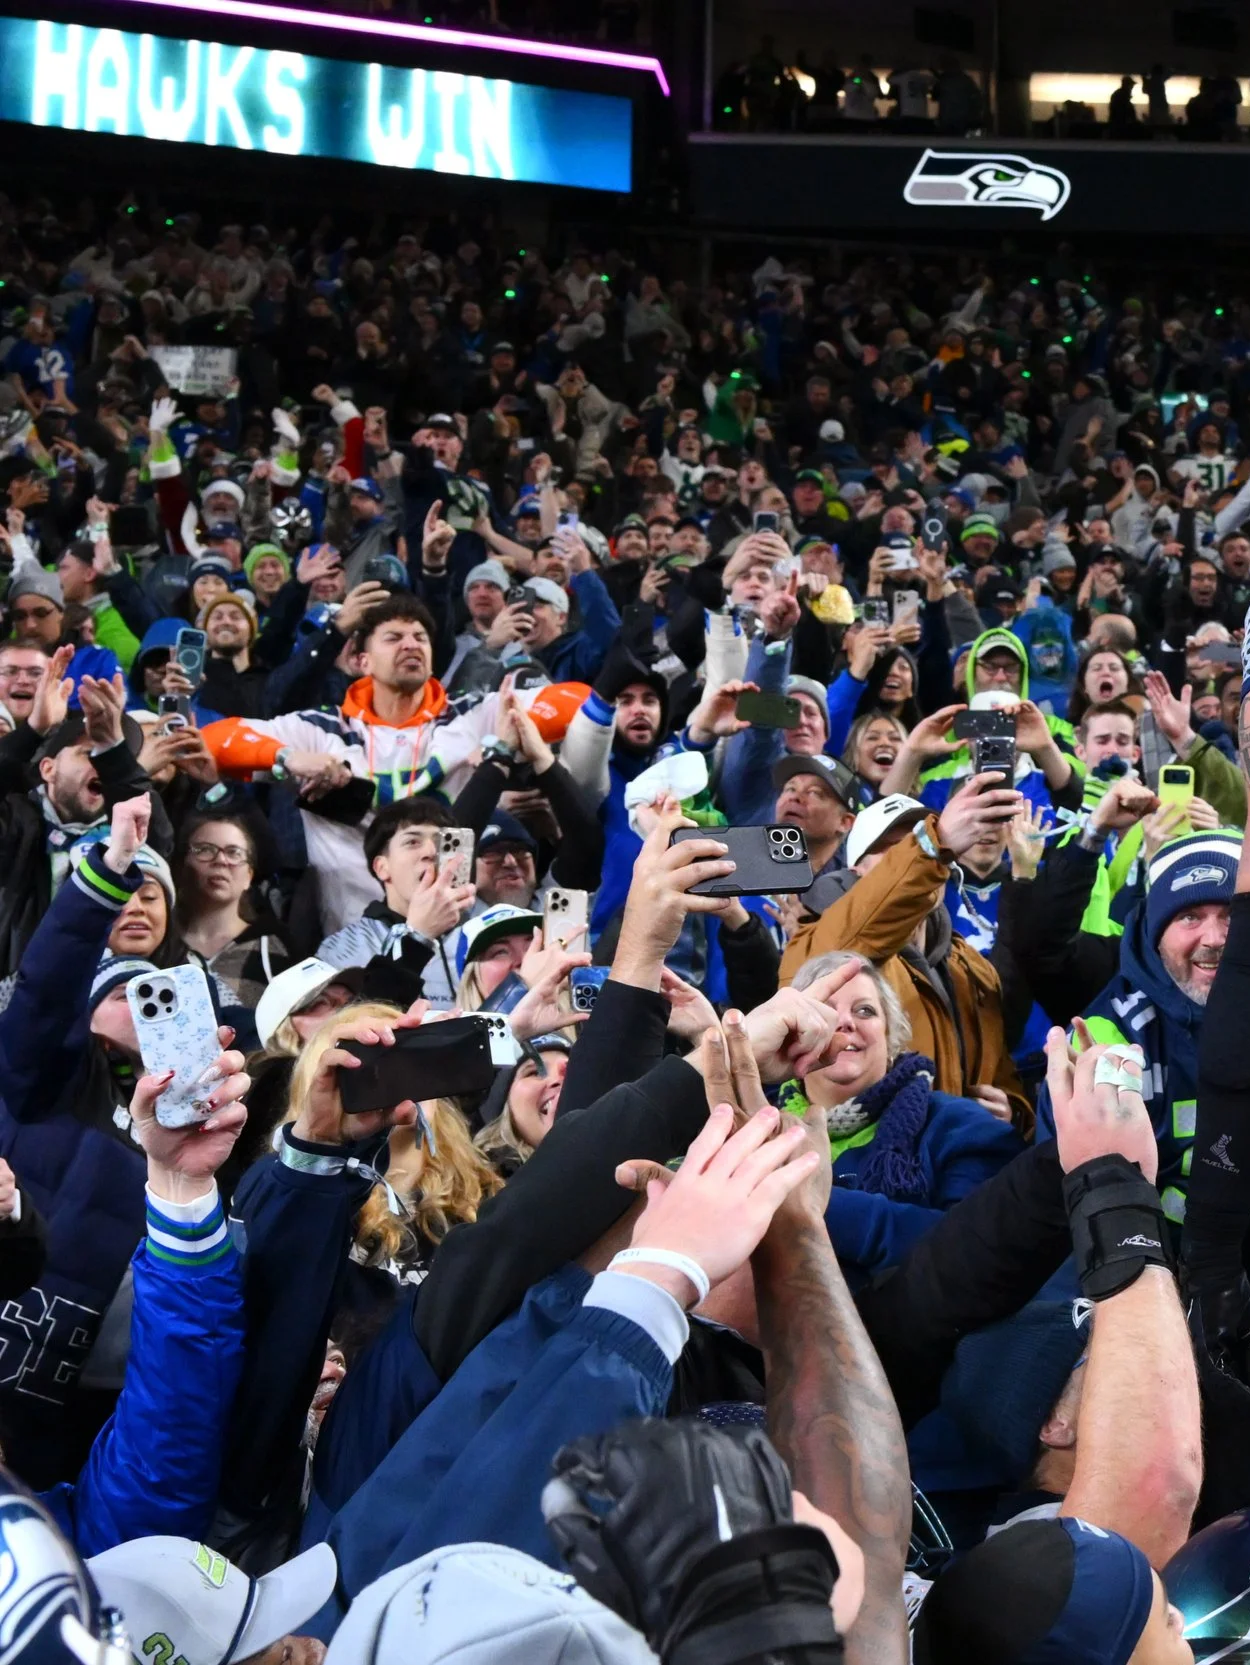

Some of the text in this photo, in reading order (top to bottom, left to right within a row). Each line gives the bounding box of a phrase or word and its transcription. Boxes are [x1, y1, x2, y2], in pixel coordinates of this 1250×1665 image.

[30, 19, 516, 180] HAWKS WIN
[34, 346, 70, 384] 12
[1197, 463, 1226, 490] 31
